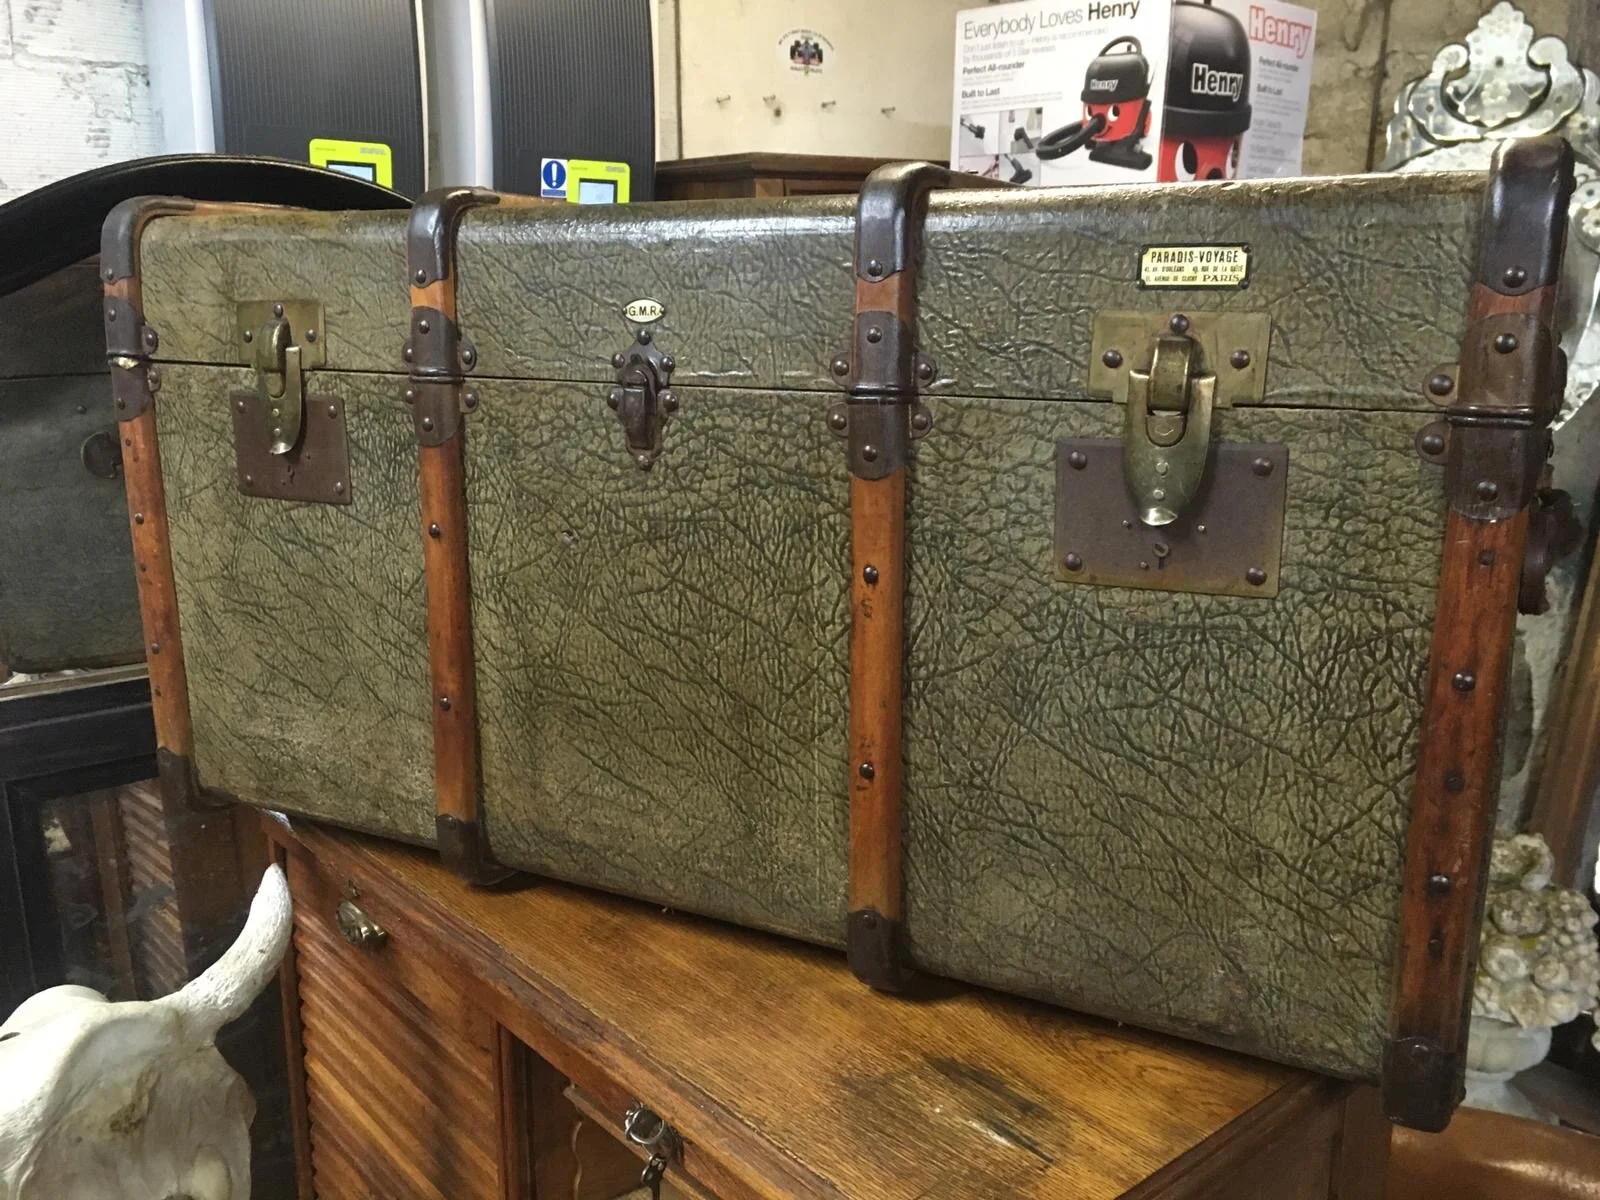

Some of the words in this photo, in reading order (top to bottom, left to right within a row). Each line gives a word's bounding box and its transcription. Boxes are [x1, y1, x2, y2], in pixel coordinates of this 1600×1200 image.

[964, 12, 1036, 40] Everybody
[1039, 8, 1083, 29] Loves
[1088, 0, 1140, 21] Henry
[1248, 5, 1312, 59] Henry
[962, 65, 987, 75] Perfect
[987, 61, 1025, 73] All-rounder
[1090, 79, 1119, 92] Henry
[1191, 62, 1243, 102] Henry
[961, 89, 976, 99] Built
[977, 89, 984, 97] to
[986, 87, 1000, 97] Last
[1151, 250, 1238, 263] PARADIS-VOYAGE
[1203, 274, 1240, 282] PARIS
